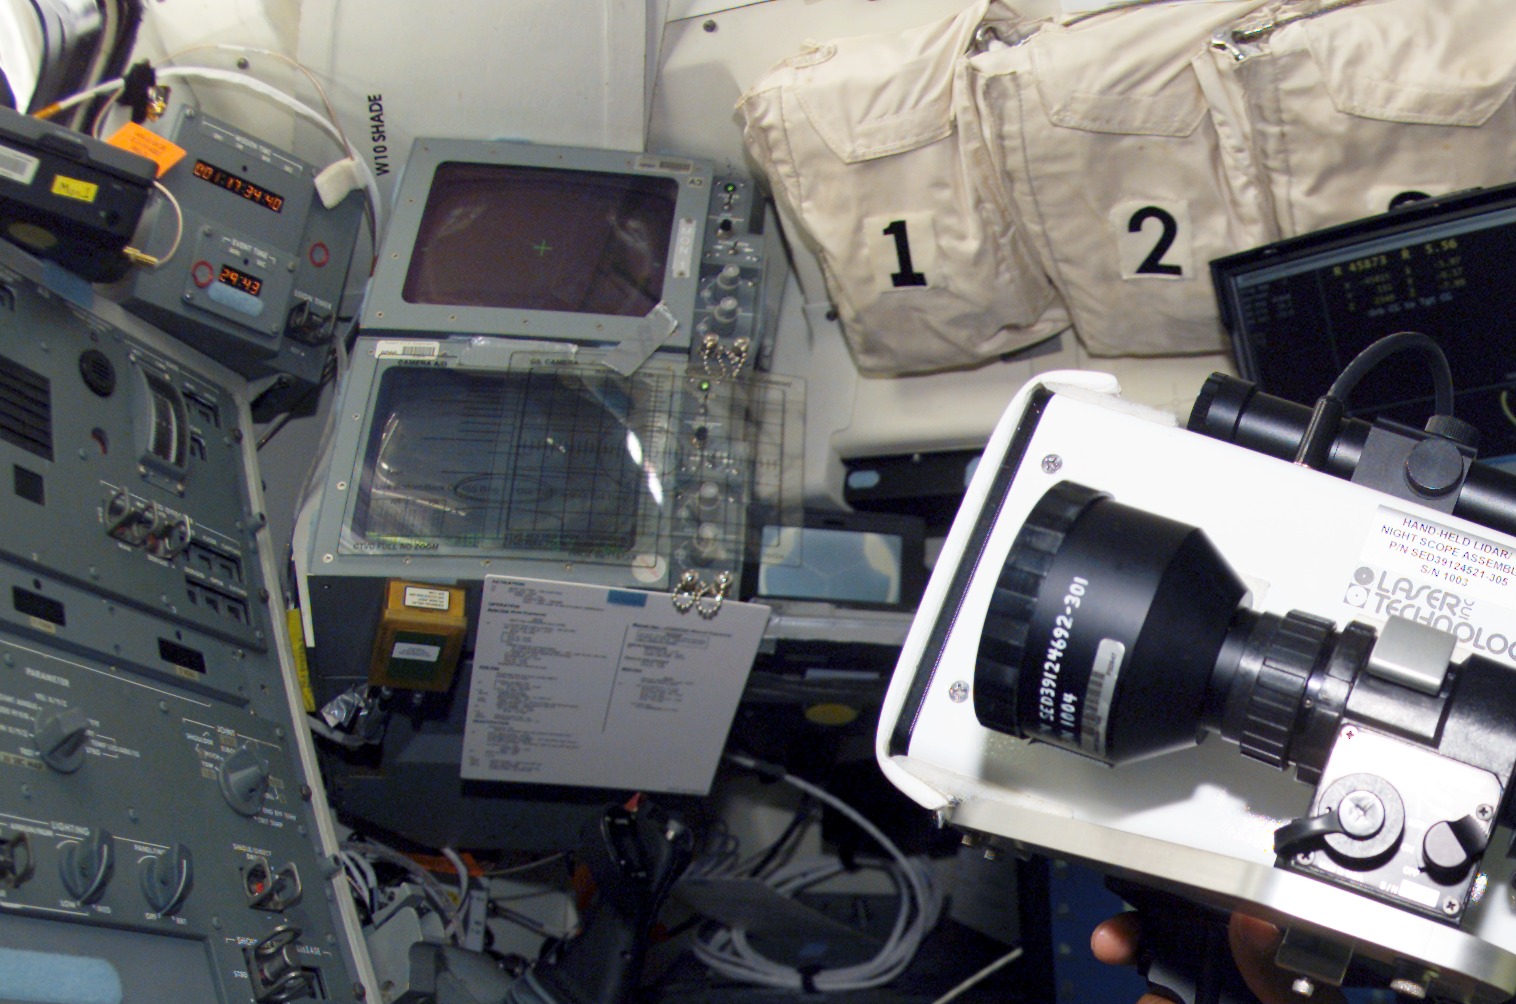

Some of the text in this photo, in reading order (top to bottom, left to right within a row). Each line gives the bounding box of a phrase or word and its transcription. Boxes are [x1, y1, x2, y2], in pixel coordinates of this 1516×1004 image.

[368, 94, 390, 176] W10 SHADE
[883, 220, 928, 287] 1
[1128, 206, 1183, 275] 2
[219, 267, 261, 295] 29:43
[1381, 524, 1416, 542] NIGHT
[1419, 537, 1460, 557] SCOPE
[1402, 518, 1513, 560] HAND-HELD LIDAR/
[1389, 541, 1509, 587] P/N SED39124521-305
[1420, 564, 1469, 587] S/N 1003
[1377, 571, 1462, 616] LASER
[1039, 576, 1089, 721] SED39124692-301
[1060, 692, 1078, 727] 1004
